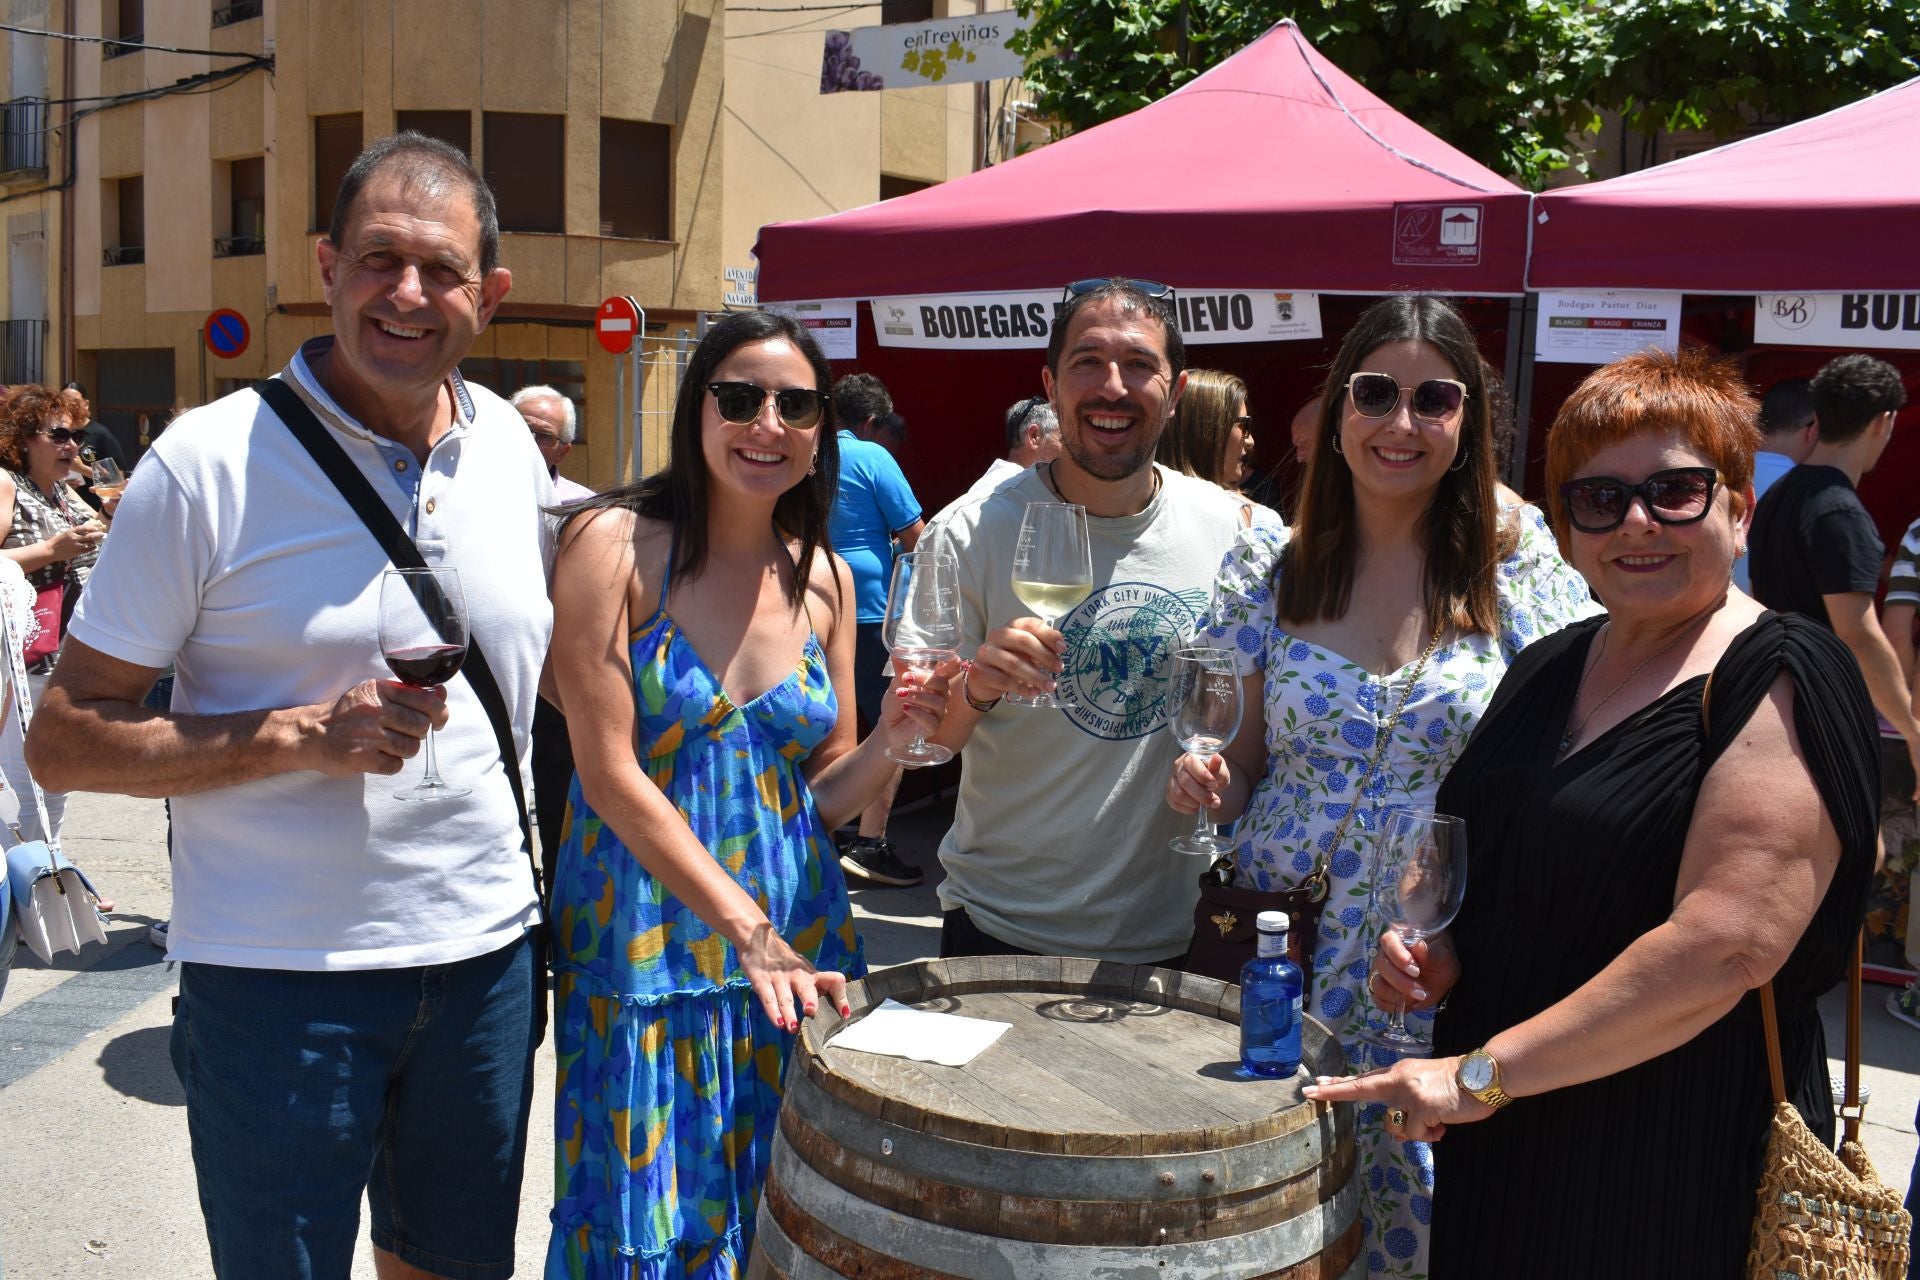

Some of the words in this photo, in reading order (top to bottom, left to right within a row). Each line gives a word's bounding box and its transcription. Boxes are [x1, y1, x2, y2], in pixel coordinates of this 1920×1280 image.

[727, 268, 753, 280] AVENID
[737, 281, 747, 292] DE
[1558, 300, 1595, 309] Bodegas
[1601, 301, 1630, 309] Pastor
[919, 302, 1048, 339] BODEGAS
[1178, 293, 1254, 333] IEVO
[826, 319, 848, 327] CRIANZA
[1554, 318, 1582, 327] BLANCO
[1593, 319, 1622, 328] ROSADO
[1632, 320, 1662, 329] CRIANZA
[1081, 595, 1111, 619] YORK
[1113, 589, 1140, 602] CITY
[1099, 635, 1164, 684] NY
[1060, 680, 1080, 705] EAST
